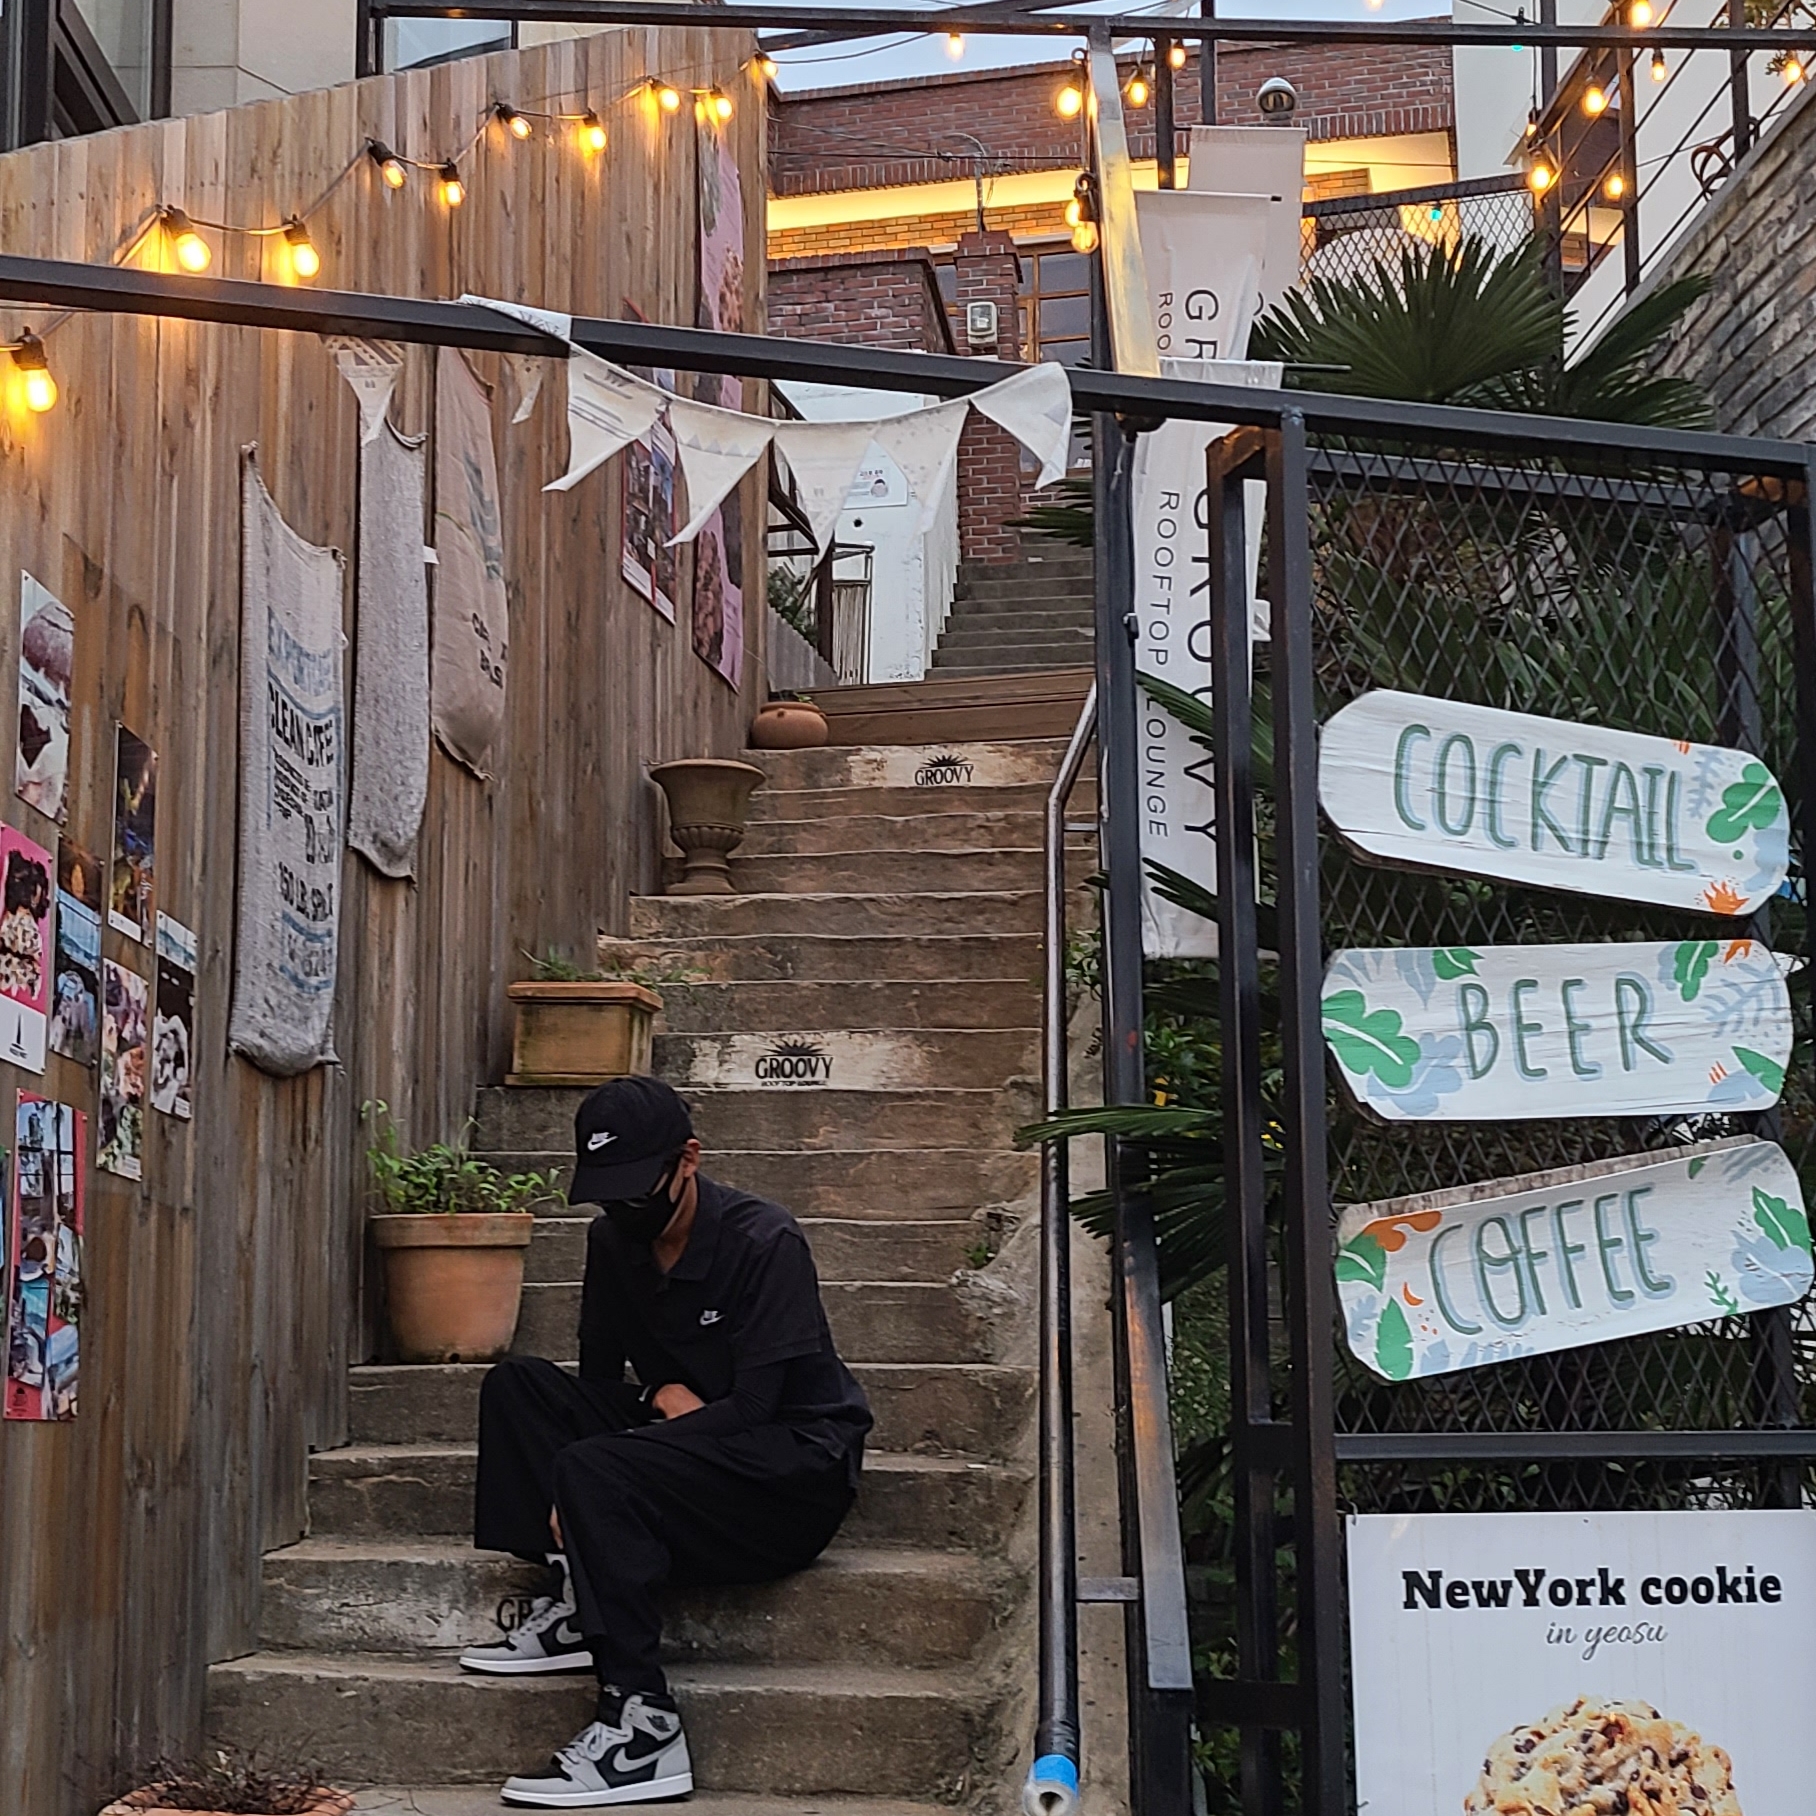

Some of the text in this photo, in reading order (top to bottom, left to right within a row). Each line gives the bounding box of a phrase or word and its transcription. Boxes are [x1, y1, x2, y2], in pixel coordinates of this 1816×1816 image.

[1145, 491, 1181, 838] ROOFTOP LOUNGE
[914, 765, 975, 786] GROOVY
[1393, 723, 1698, 871] COCKTAIL
[1456, 971, 1675, 1082] BEER
[755, 1056, 834, 1079] GROOVY
[1429, 1182, 1677, 1335] COFFEE
[1401, 1565, 1783, 1610] NewYork cookie
[1546, 1621, 1669, 1661] in yeosu
